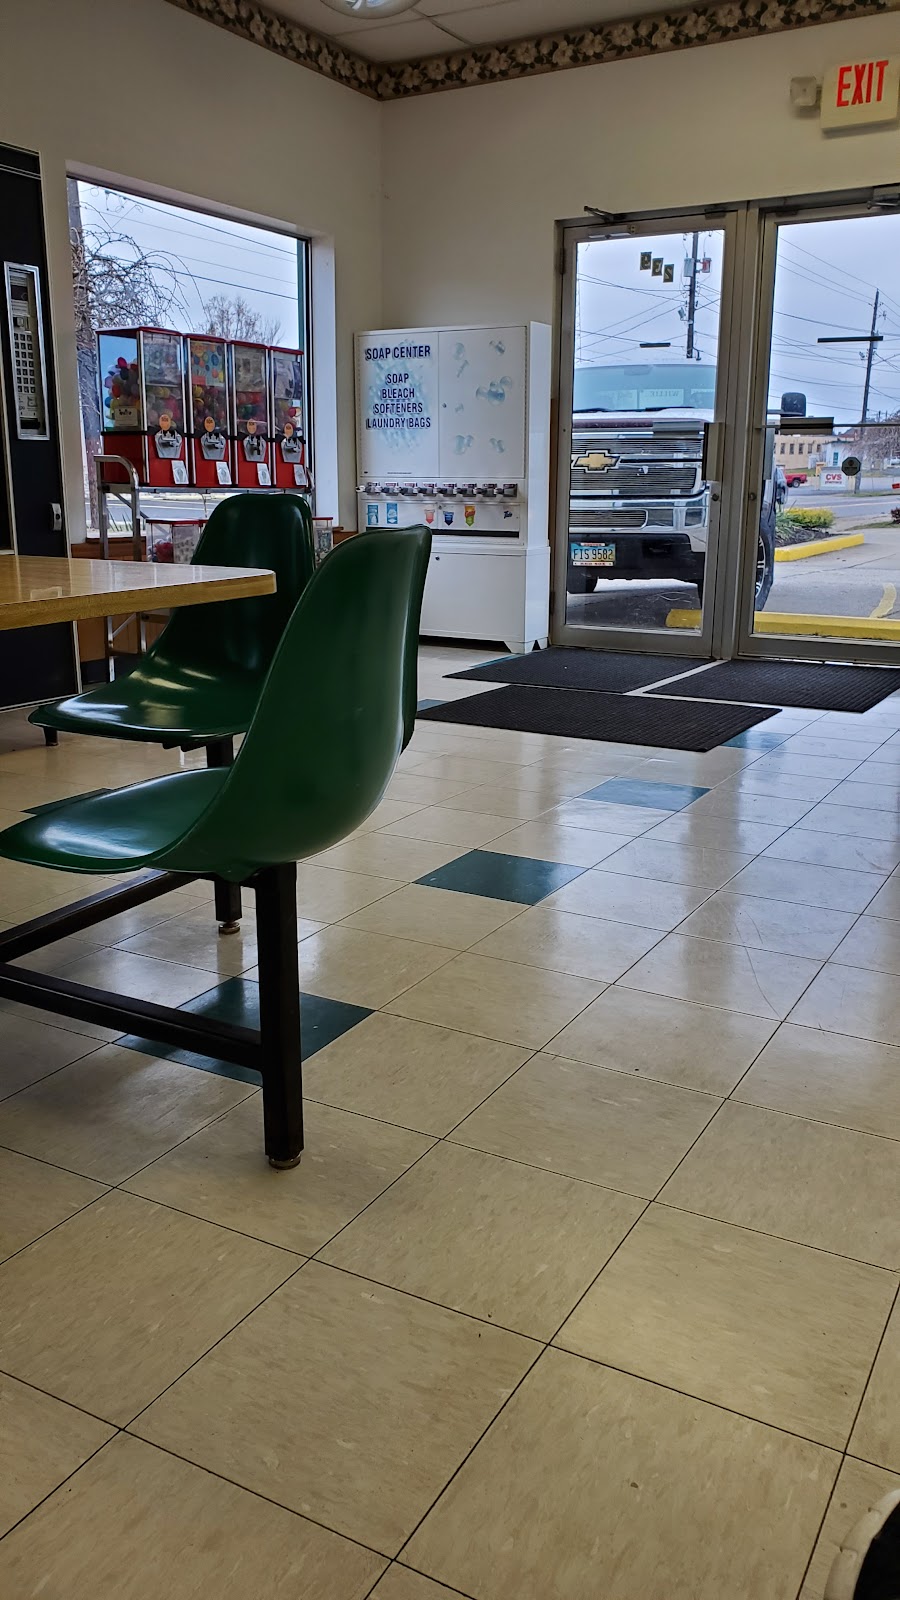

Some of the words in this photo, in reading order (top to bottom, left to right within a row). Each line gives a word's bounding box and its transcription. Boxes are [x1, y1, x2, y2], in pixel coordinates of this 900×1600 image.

[836, 60, 889, 107] EXIT
[365, 347, 391, 360] SOAP
[393, 345, 431, 358] CENTER
[386, 373, 410, 385] SOAP
[382, 387, 415, 399] BLEACH
[374, 402, 423, 414] SOFTENERS
[366, 418, 406, 429] LAUNDRY
[407, 417, 431, 428] BAGS
[573, 548, 590, 560] FIS
[591, 549, 613, 560] 9582
